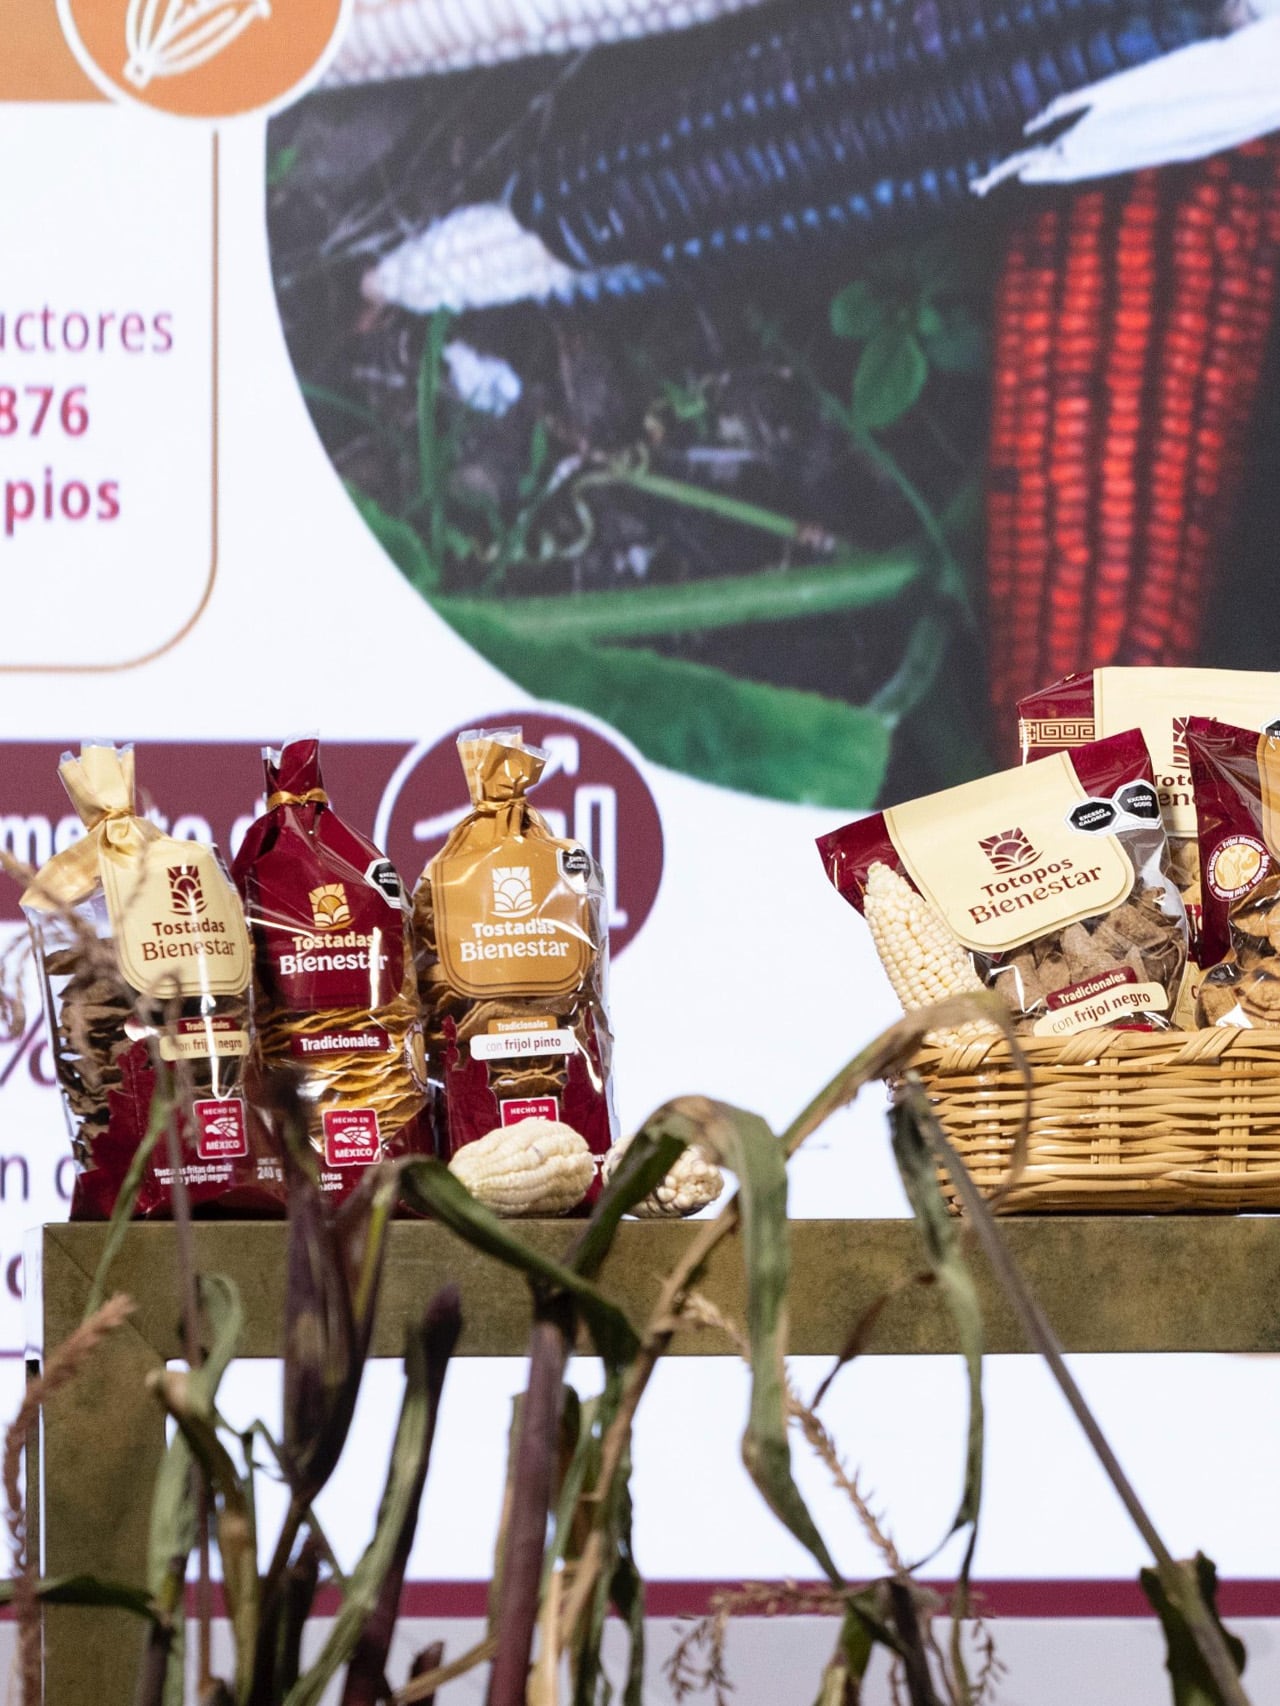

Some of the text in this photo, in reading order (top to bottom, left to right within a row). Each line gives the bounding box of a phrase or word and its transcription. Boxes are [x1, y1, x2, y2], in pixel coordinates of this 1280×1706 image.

[0, 304, 173, 351] ctores
[981, 858, 1073, 898] Totopos
[968, 866, 1102, 925] Bienestar
[152, 919, 225, 937] Tostadas
[472, 918, 556, 938] Tostadas
[142, 939, 235, 961] Bienestar
[292, 931, 374, 951] Tostadas
[460, 939, 569, 963] Bienestar
[1058, 971, 1127, 1005] Tradicionales
[1052, 991, 1151, 1034] con frijol negro
[496, 1020, 548, 1031] Tradicionales
[218, 1039, 242, 1051] negro
[301, 1034, 380, 1052] Tradicionales
[504, 1037, 531, 1053] frijol
[534, 1037, 561, 1050] pinto
[332, 1116, 369, 1124] HECHO EN
[510, 1106, 536, 1114] HECHO
[334, 1147, 373, 1158] MÉXICO
